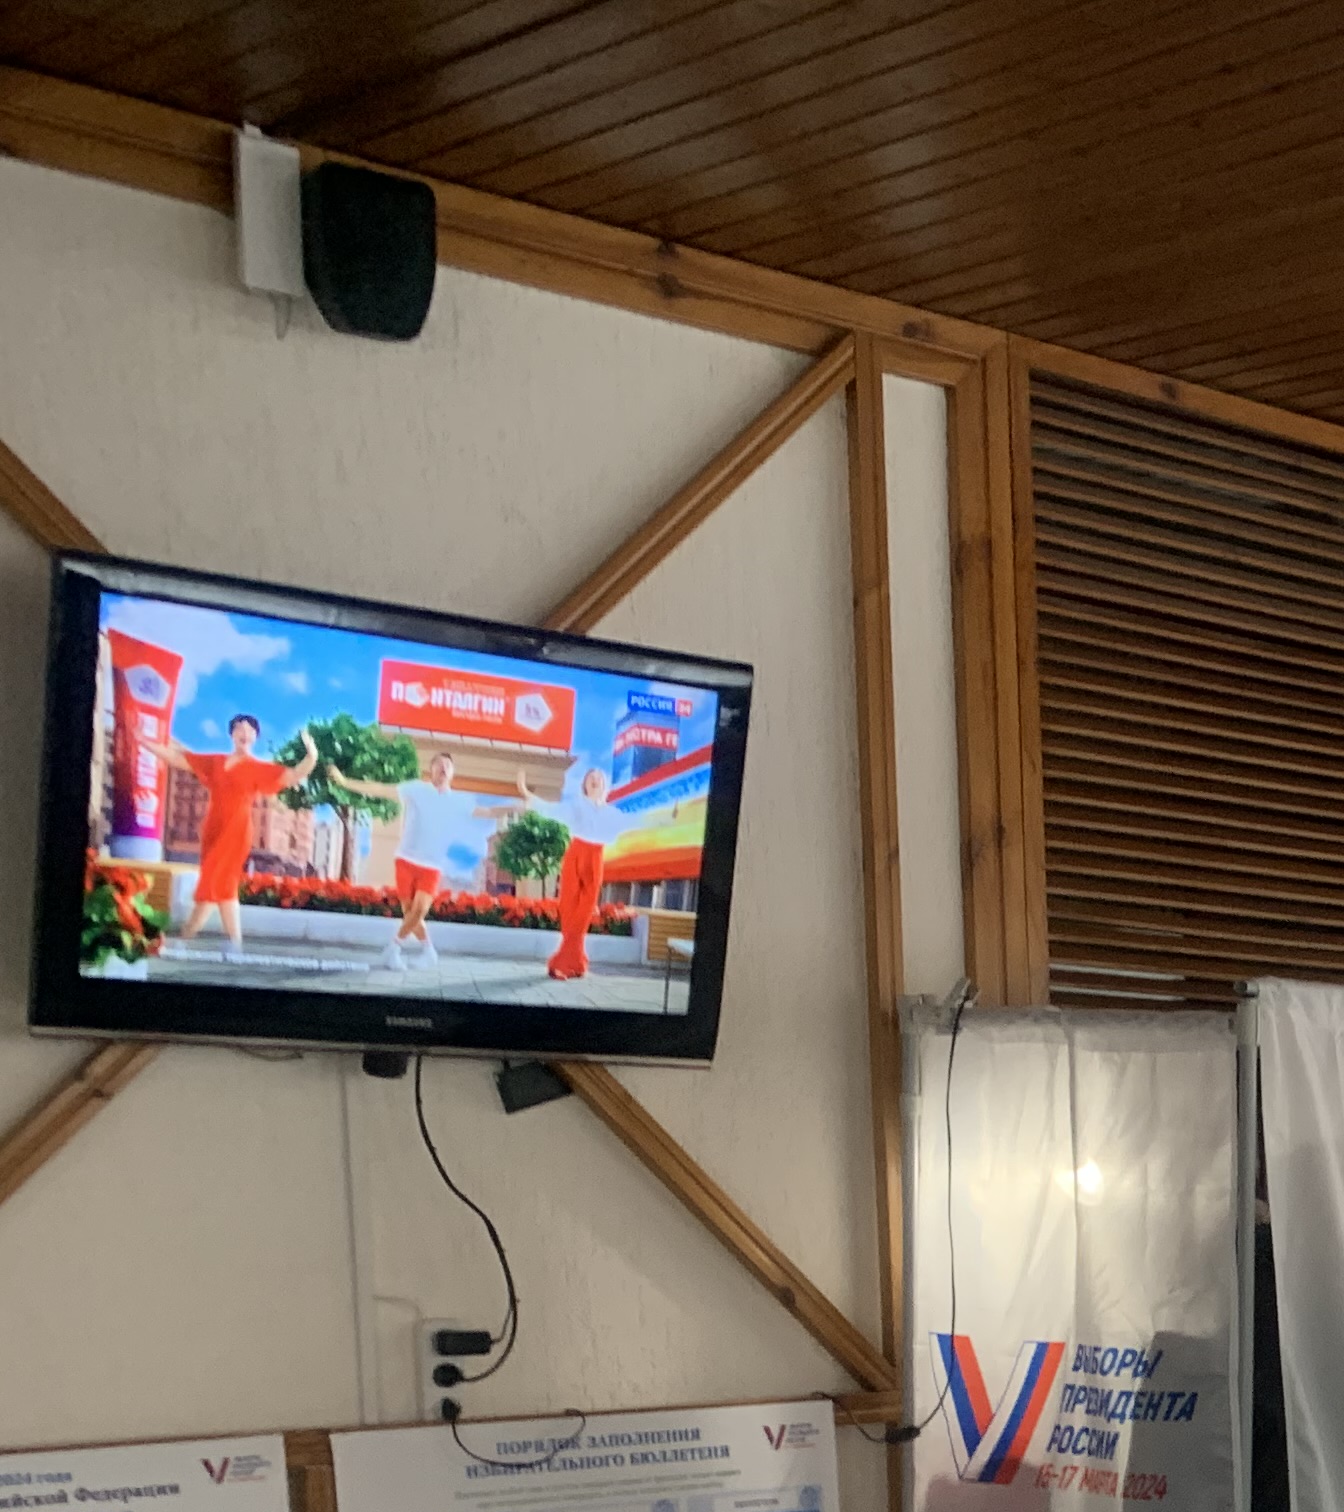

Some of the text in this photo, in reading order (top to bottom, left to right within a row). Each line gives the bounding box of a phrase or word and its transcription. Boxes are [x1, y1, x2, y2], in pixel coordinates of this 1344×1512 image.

[1071, 1343, 1164, 1380] ВЫБОРЫ
[496, 1427, 702, 1456] ПОРЯДОК ЗАПОЛНЕНИЯ
[630, 1445, 731, 1466] БЮЛЛЕТЕНЯ
[74, 1483, 181, 1504] Федерации
[1122, 1472, 1168, 1500] 2024
